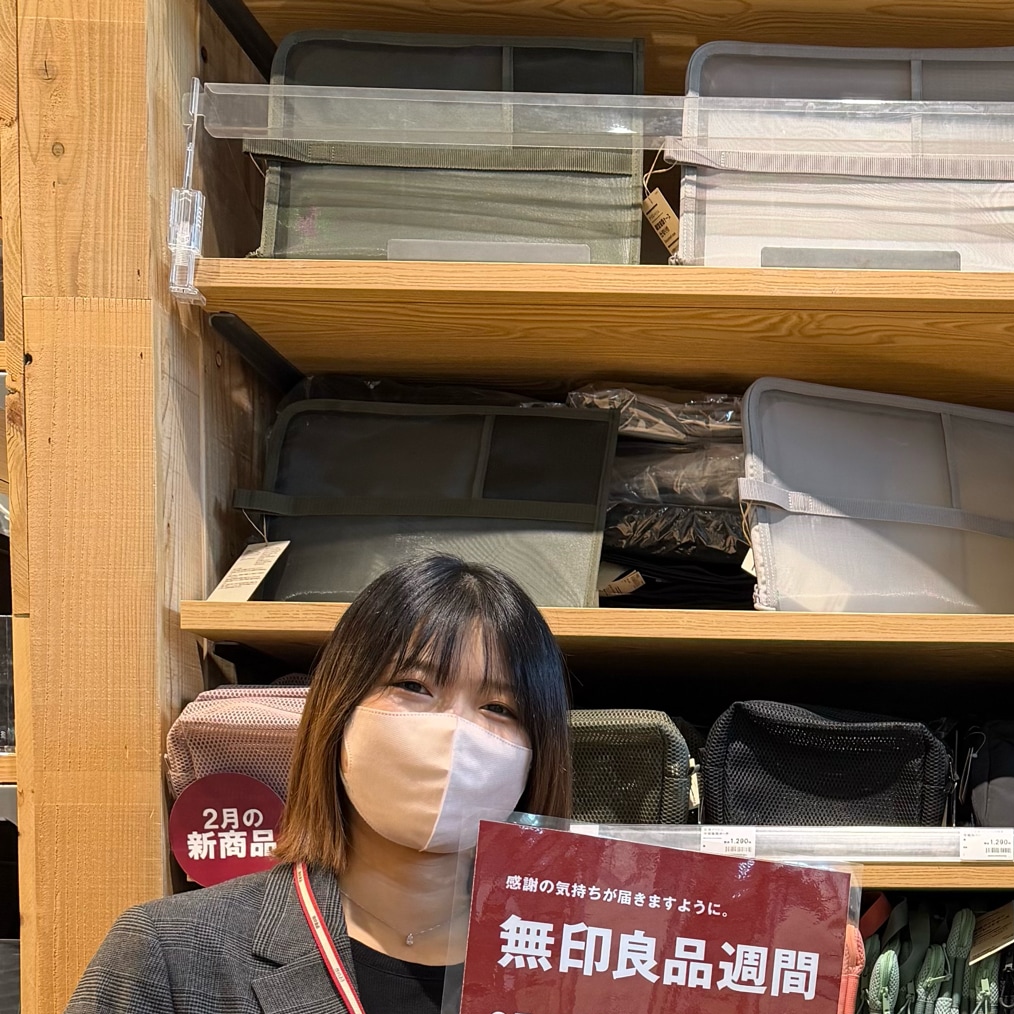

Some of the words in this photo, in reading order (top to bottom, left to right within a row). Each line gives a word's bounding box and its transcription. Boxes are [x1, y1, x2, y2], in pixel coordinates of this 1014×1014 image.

[203, 808, 263, 829] 2月の
[187, 830, 277, 860] 新商品
[506, 875, 728, 917] 感謝の気持ちが届きますように。
[498, 914, 820, 1000] 無印良品週間
